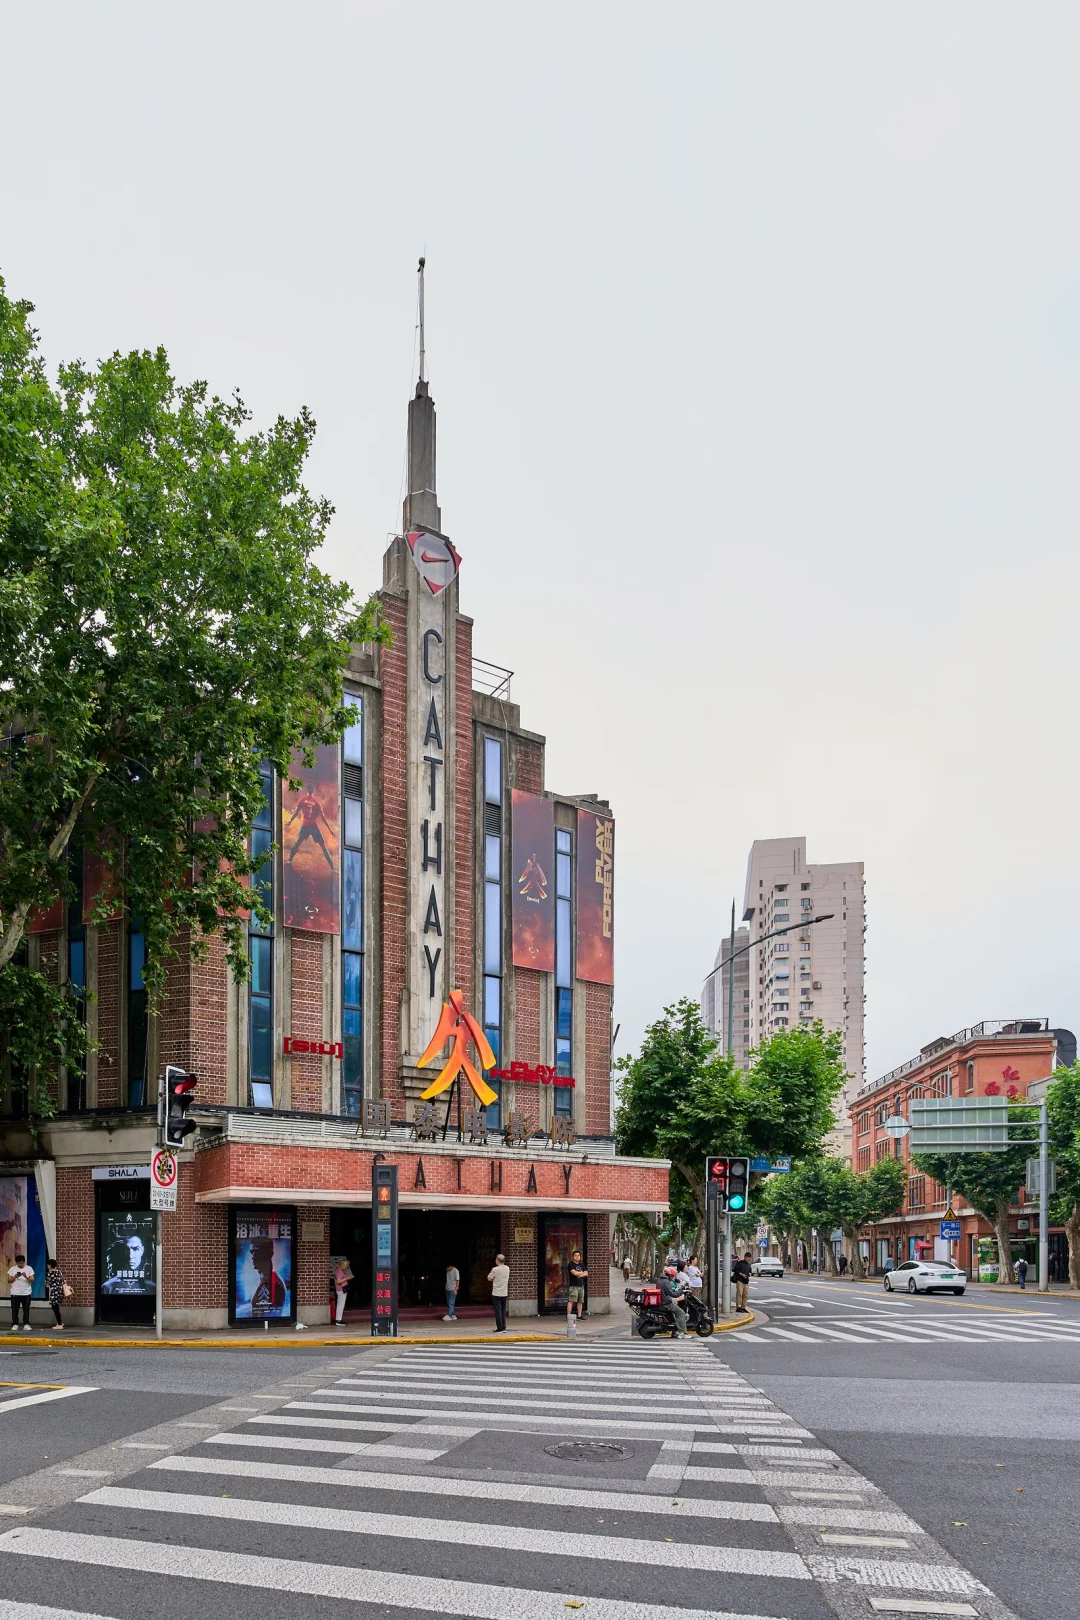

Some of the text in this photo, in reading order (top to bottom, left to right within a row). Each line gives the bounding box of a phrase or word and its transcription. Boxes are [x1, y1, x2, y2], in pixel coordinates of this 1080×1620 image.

[423, 629, 443, 998] CATHAY
[595, 817, 605, 883] PLAY
[603, 820, 613, 938] FOREVER
[490, 1068, 575, 1088] FOREVER
[511, 1061, 557, 1076] PLAY
[361, 1098, 577, 1145] 国泰电影院
[414, 1156, 572, 1195] ATHAY
